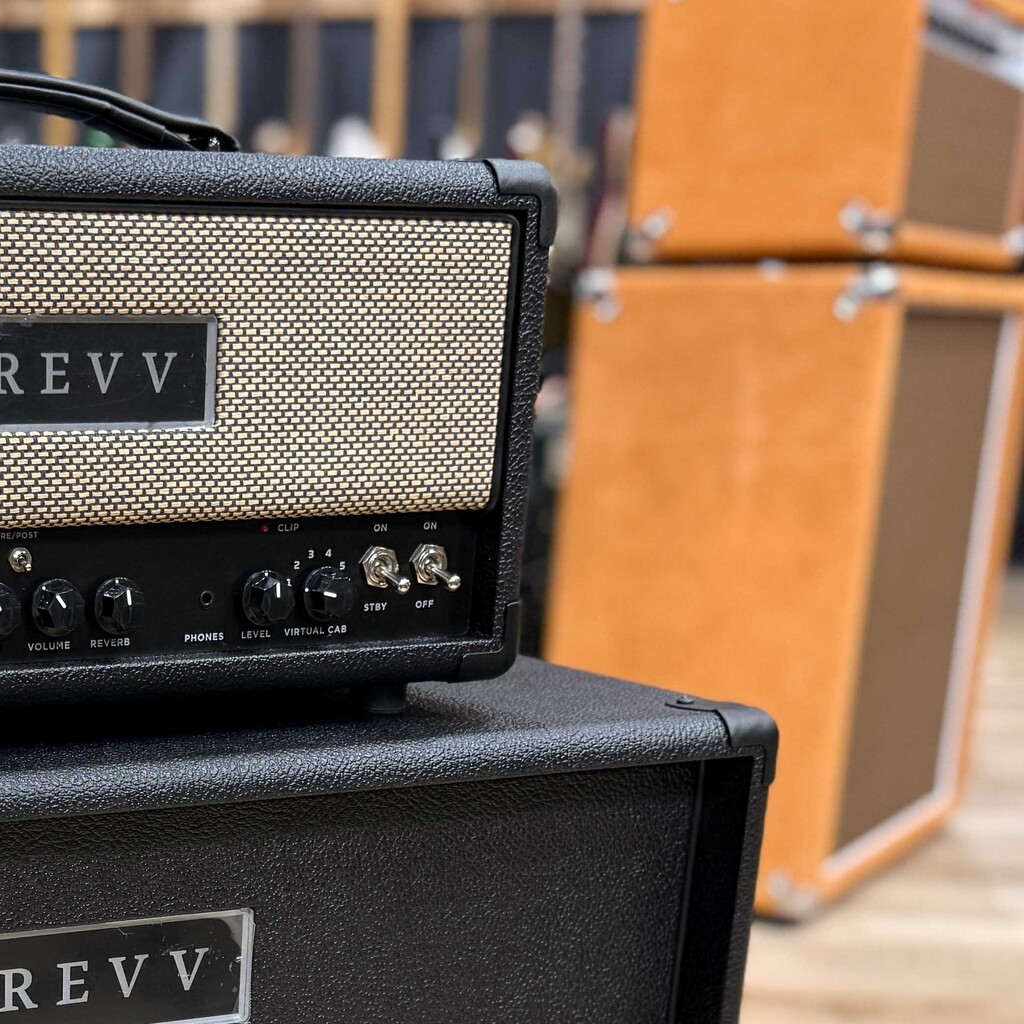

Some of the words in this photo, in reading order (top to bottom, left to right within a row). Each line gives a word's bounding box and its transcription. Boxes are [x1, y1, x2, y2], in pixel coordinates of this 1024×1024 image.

[277, 523, 300, 532] CLIP
[374, 523, 388, 532] ON
[423, 521, 438, 531] ON
[293, 560, 300, 570] 2
[308, 549, 315, 559] 3
[325, 548, 332, 558] 4
[339, 561, 346, 570] 5
[363, 602, 388, 612] STBY
[415, 599, 434, 609] OFF
[241, 629, 271, 639] LEVEL
[284, 626, 325, 637] VIRTUAL
[327, 624, 347, 634] CAB
[90, 637, 131, 648] REVERB
[184, 632, 224, 643] PHONES
[27, 640, 71, 652] VOLUME
